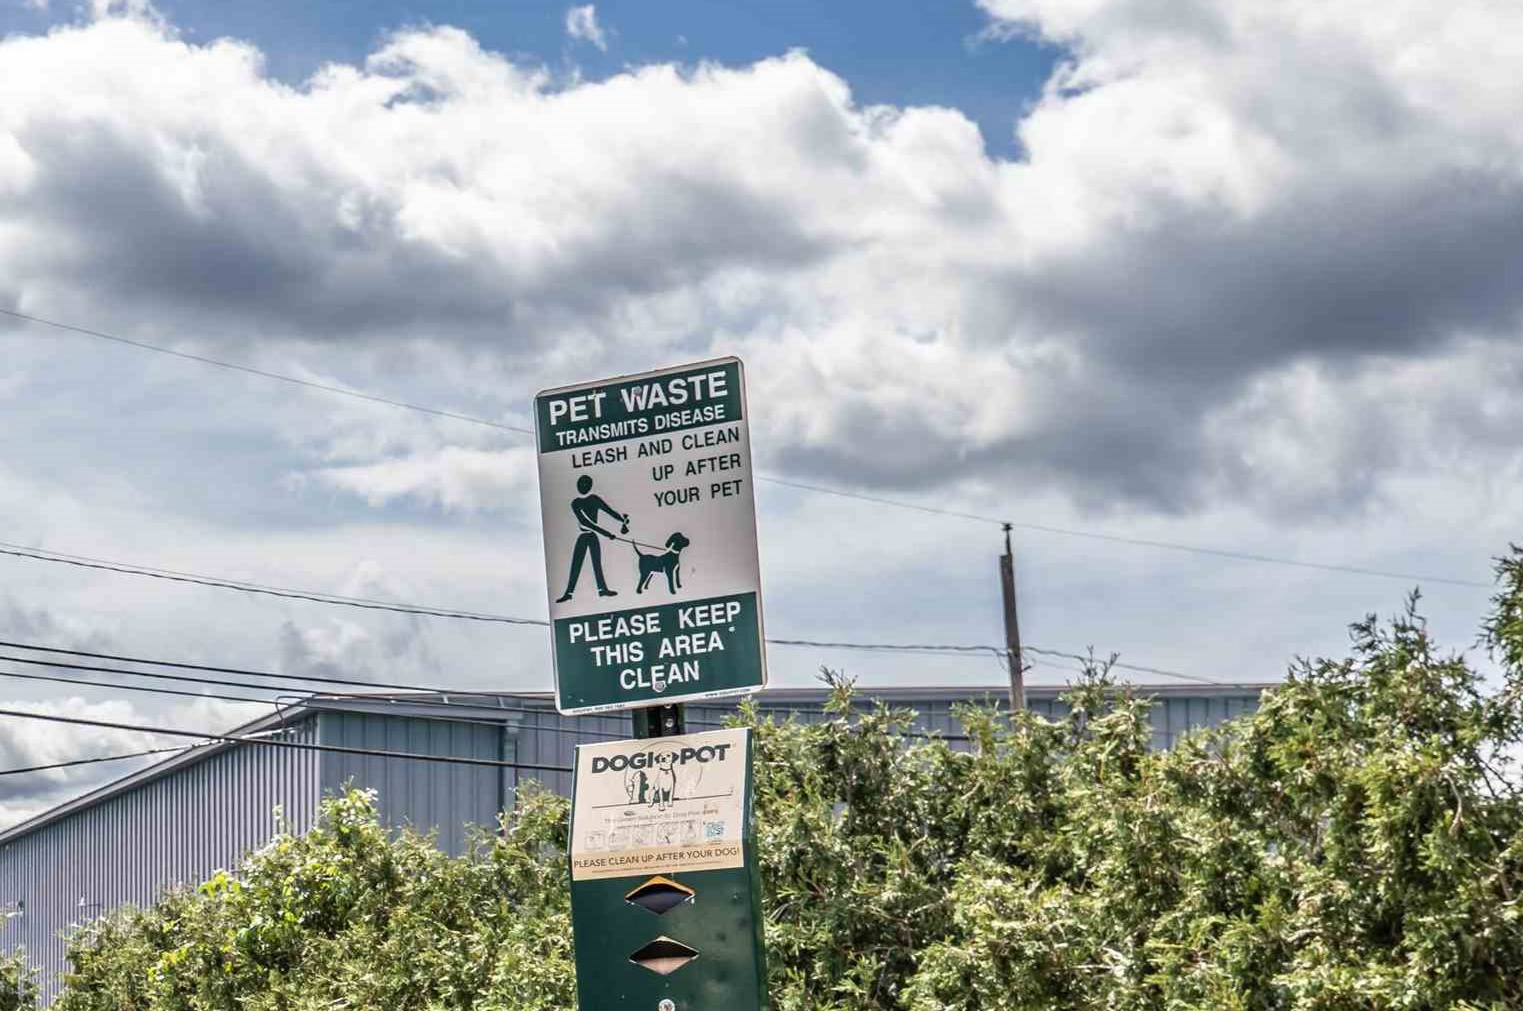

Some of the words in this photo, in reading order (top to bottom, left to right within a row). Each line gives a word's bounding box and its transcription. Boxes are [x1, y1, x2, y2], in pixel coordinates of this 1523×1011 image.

[549, 392, 607, 426] PET
[621, 371, 728, 413] WASTE
[556, 418, 649, 447] TRANSMITS
[654, 404, 726, 431] DISEASE
[571, 445, 627, 469] LEASH
[637, 438, 673, 459] AND
[681, 427, 740, 451] CLEAN
[652, 464, 675, 482] UP
[685, 453, 741, 477] AFTER
[654, 486, 700, 508] YOUR
[711, 479, 743, 499] PET
[569, 612, 661, 644] PLEASE
[678, 601, 741, 629] KEEP
[590, 642, 644, 667] THIS
[658, 631, 724, 659] AREA
[619, 660, 700, 690] CLEAN
[574, 858, 606, 869] PLEASE
[608, 854, 640, 866] CLEAN
[642, 854, 654, 863] UP
[655, 851, 685, 862] AFTER
[687, 849, 713, 860] YOUR
[714, 846, 739, 857] DOG!
